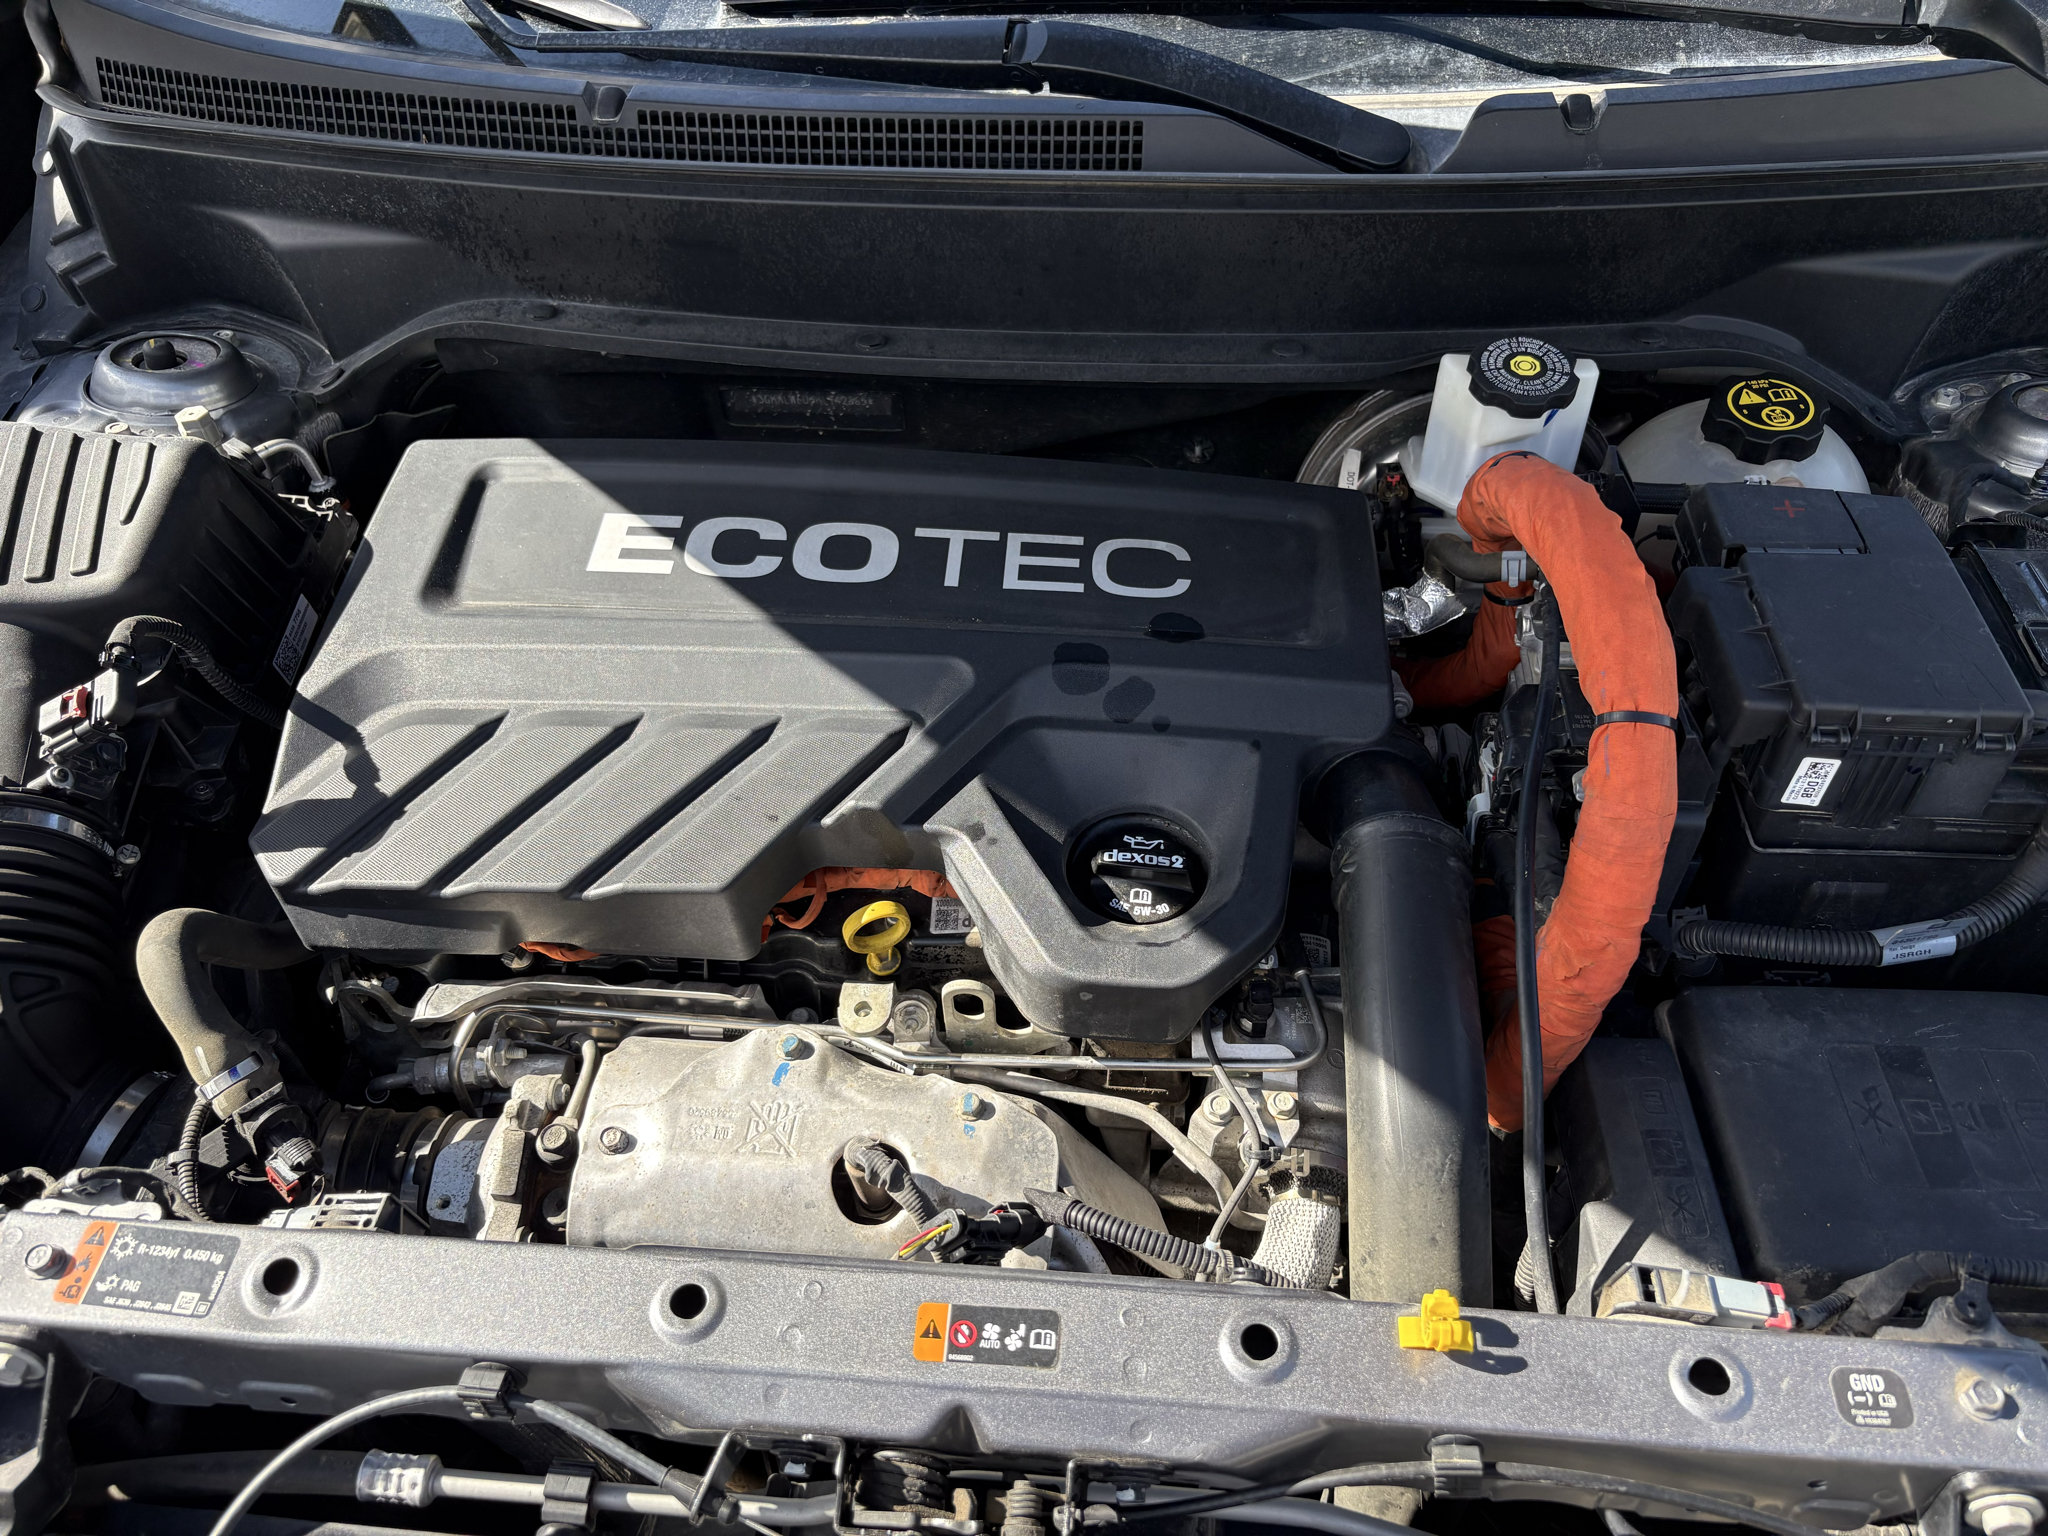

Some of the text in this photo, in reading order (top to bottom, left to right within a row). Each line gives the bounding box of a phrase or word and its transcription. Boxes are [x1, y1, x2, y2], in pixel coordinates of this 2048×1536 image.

[1518, 336, 1545, 345] BOUCHON
[1544, 343, 1560, 353] AVANT
[1519, 342, 1541, 350] LIQUIDE
[1526, 347, 1544, 357] BIDON
[1490, 369, 1501, 377] CAP
[1497, 376, 1517, 388] BEFORE
[1493, 380, 1508, 391] FLUID
[1506, 386, 1523, 395] FROM
[1528, 388, 1550, 397] SEALED
[1548, 375, 1570, 393] CONTAINER
[586, 512, 1192, 599] ECOTEC
[1801, 781, 1819, 798] DGB
[1103, 848, 1184, 869] dexos2
[1109, 898, 1170, 916] SAE 5W-30
[1892, 948, 1931, 959] JSRGH
[137, 1242, 225, 1265] R-1234yf 0.450 kg
[120, 1279, 142, 1293] PAG
[979, 1338, 1001, 1349] AUTO
[1849, 1373, 1885, 1392] GND
